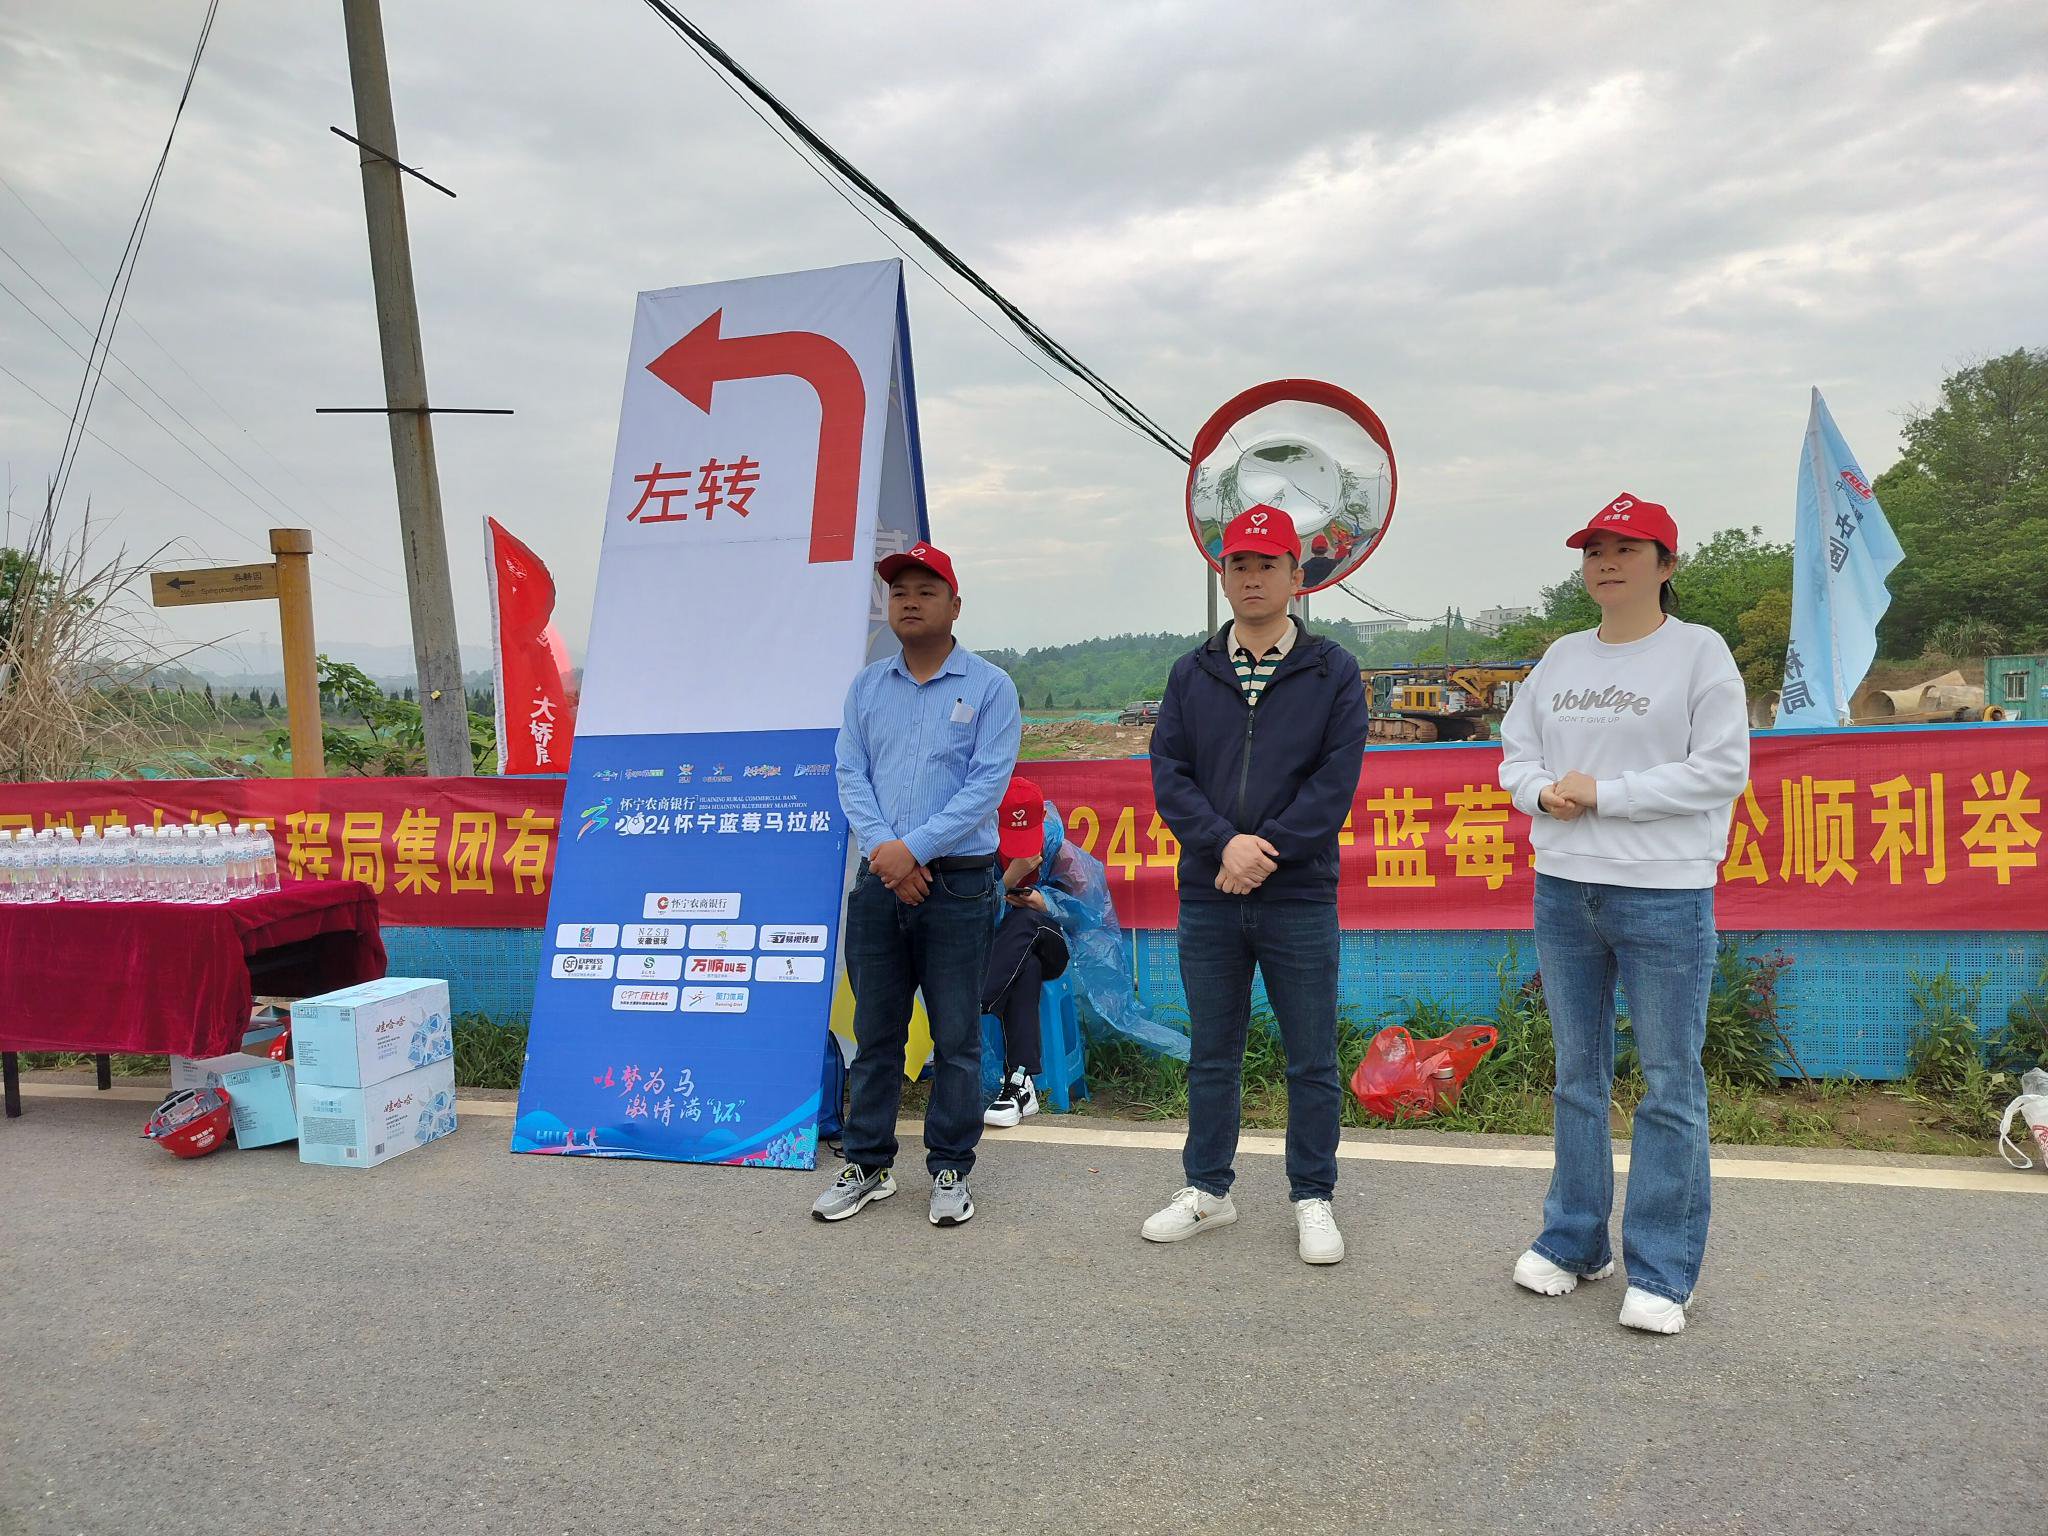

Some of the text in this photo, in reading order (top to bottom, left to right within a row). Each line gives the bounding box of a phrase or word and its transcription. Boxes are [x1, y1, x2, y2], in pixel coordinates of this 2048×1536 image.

[626, 455, 760, 524] 左转
[619, 796, 696, 811] 怀宁农商银行
[691, 958, 747, 973] 万顺叫车
[593, 1064, 695, 1098] 以梦为马
